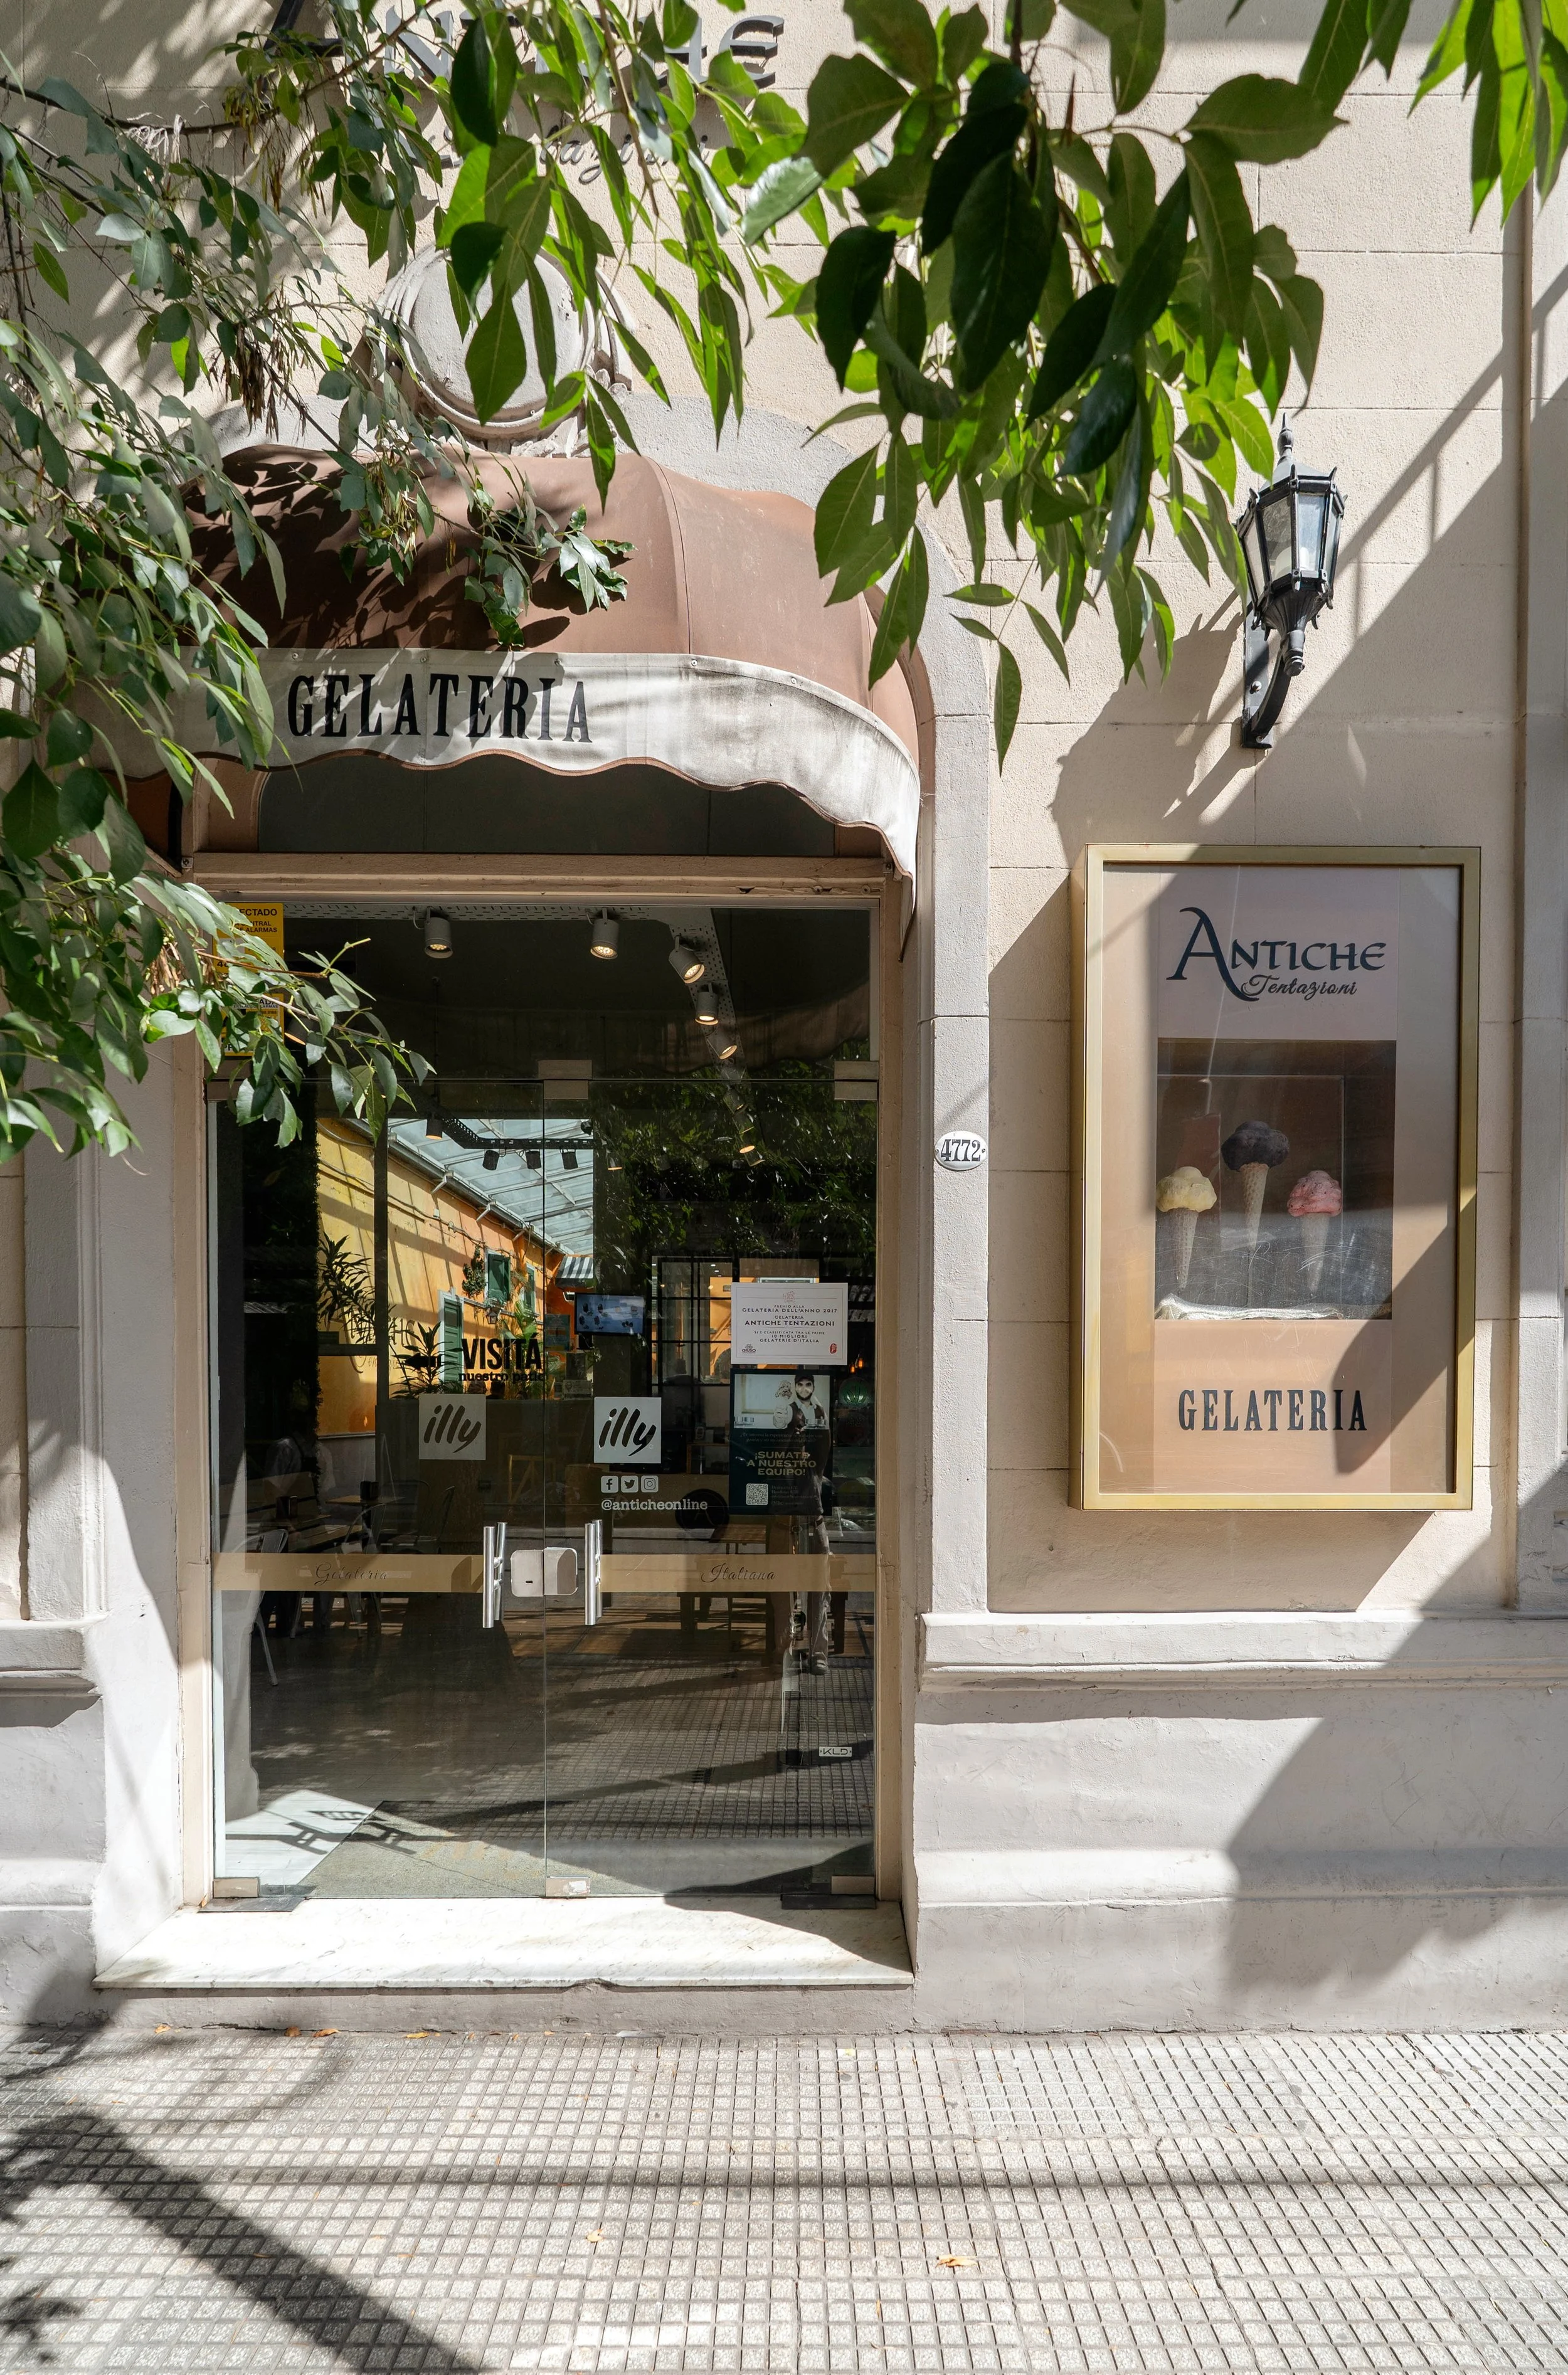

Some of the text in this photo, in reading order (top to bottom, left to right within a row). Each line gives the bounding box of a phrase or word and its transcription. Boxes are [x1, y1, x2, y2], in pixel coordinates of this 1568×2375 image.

[288, 674, 593, 743] GELATERIA
[240, 908, 277, 916] ECTADO
[1166, 907, 1387, 1002] ANTICHE
[1241, 974, 1357, 1000] Tentazioni
[941, 1139, 980, 1161] 4772
[462, 1332, 541, 1370] VISITÁ
[458, 1372, 509, 1381] nuestro
[1179, 1389, 1367, 1431] GELATERIA
[423, 1404, 481, 1453] illy
[598, 1407, 657, 1456] illy
[601, 1498, 708, 1511] @anticheonline
[314, 1562, 387, 1585] Gelateria
[701, 1562, 775, 1582] Italiana
